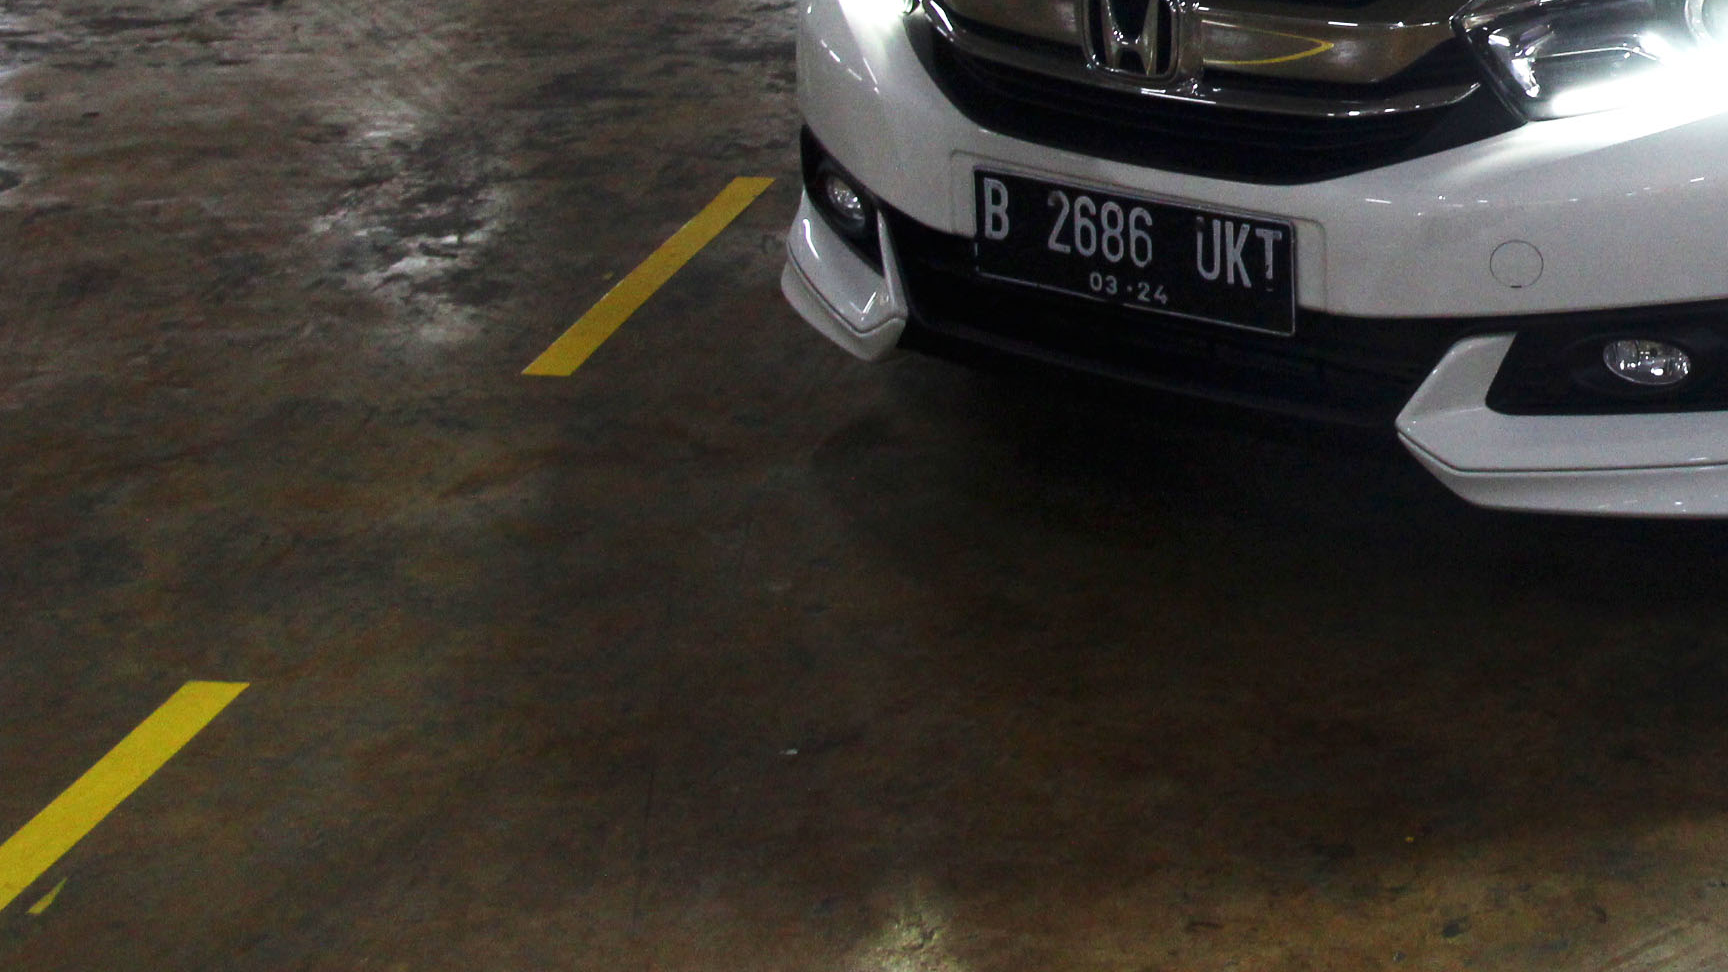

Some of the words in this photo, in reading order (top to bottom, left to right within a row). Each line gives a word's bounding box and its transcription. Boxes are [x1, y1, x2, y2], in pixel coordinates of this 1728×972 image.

[983, 178, 1010, 241] B
[1047, 190, 1153, 268] 2686
[1196, 217, 1283, 291] UKT
